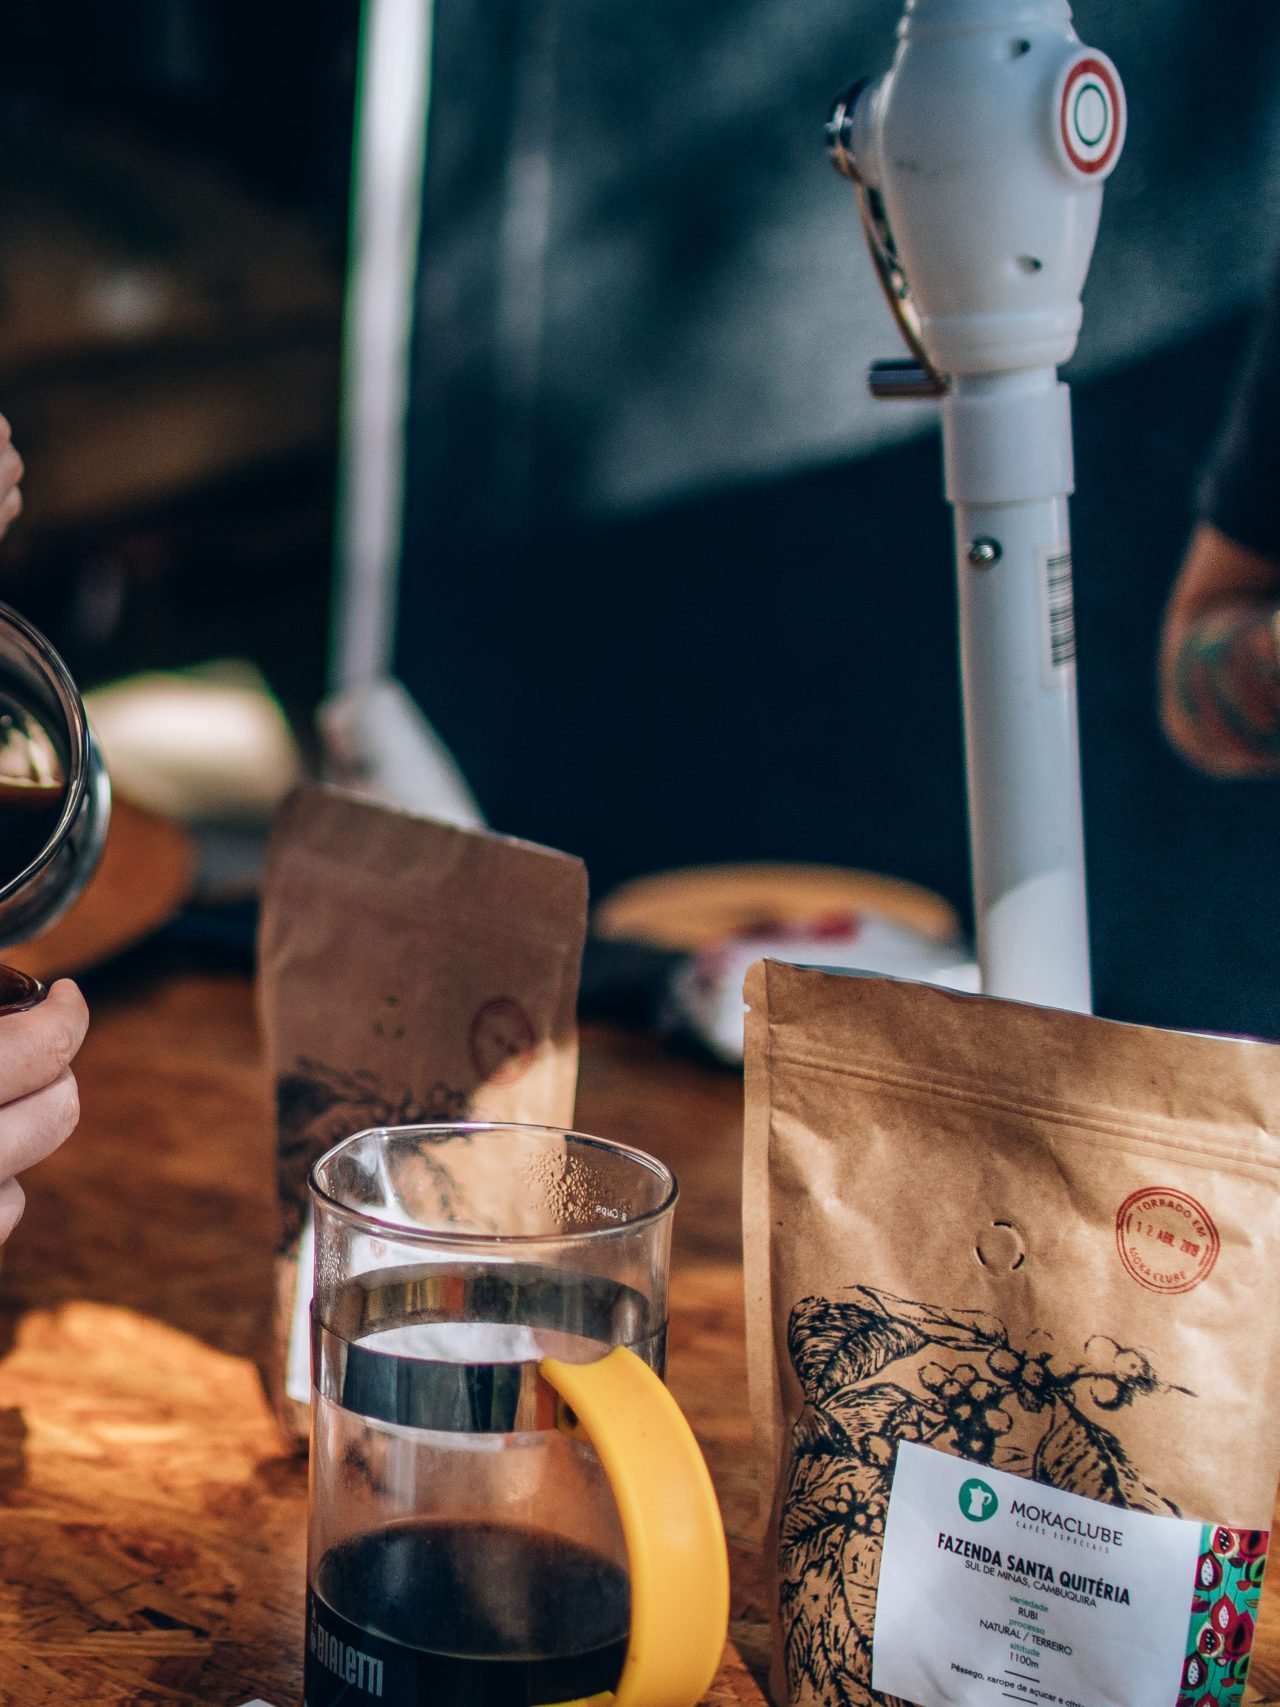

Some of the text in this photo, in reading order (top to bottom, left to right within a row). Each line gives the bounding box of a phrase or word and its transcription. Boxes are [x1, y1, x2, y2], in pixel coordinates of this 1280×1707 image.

[1136, 1199, 1207, 1237] TORRADO EM
[1009, 1500, 1124, 1547] MOKACLUBE
[937, 1532, 1131, 1606] FAZENDA SANTA QUITÉRIA
[965, 1559, 1098, 1608] SUL DE MINAS, CAMBUQUIRA
[1008, 1595, 1049, 1612] variedade
[1018, 1606, 1039, 1620] RUBI
[979, 1619, 1073, 1656] NATURAL / TERREIRO
[1008, 1619, 1046, 1635] processo
[1009, 1642, 1041, 1657] altitude
[1010, 1652, 1040, 1669] 1100m
[987, 1675, 1015, 1689] xarope
[1017, 1683, 1028, 1693] de
[1058, 1697, 1064, 1705] e
